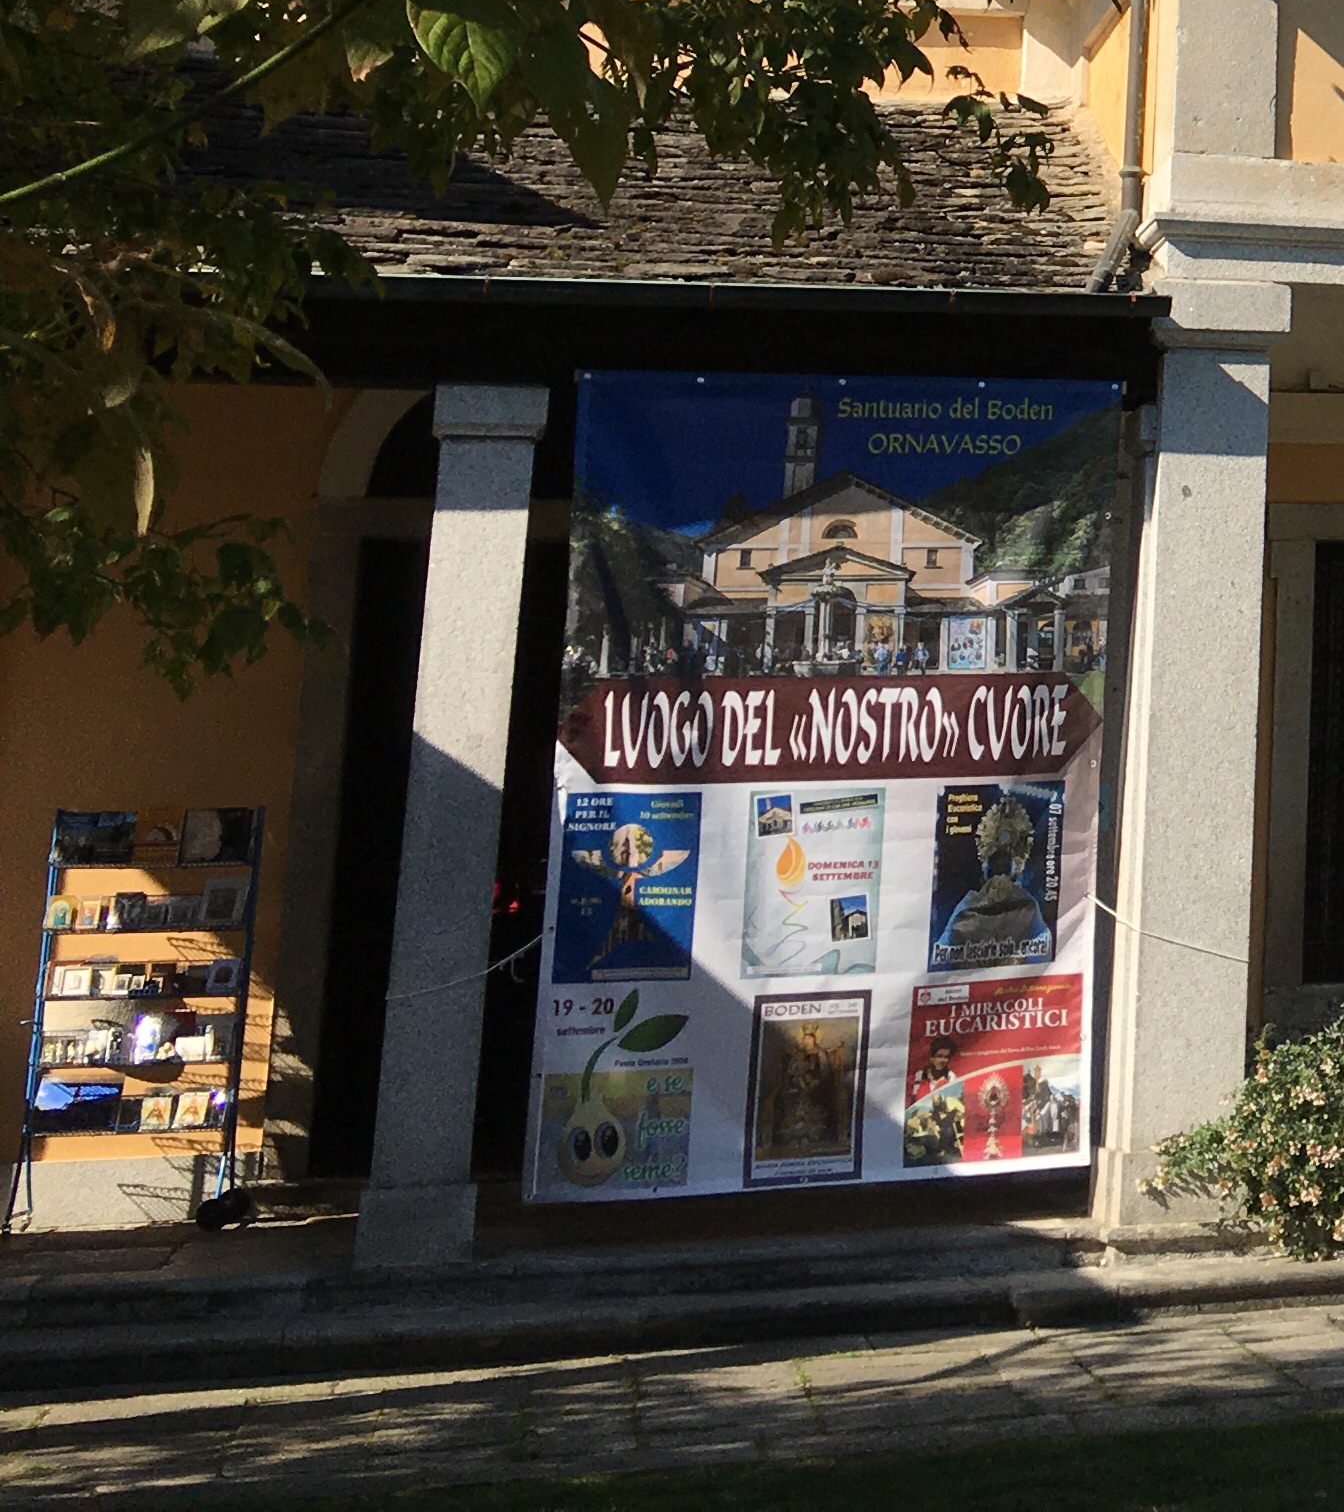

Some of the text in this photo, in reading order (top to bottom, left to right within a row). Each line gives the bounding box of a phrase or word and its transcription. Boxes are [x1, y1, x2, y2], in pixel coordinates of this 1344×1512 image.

[837, 396, 1054, 420] Santuario del Boden
[867, 433, 1022, 455] ORNAVASSO
[603, 690, 713, 768] LUOGO
[721, 690, 781, 766] DEL
[967, 683, 1069, 760] CUORE
[576, 797, 614, 807] 12 ORE
[1049, 803, 1062, 815] 07
[575, 810, 596, 819] PER
[567, 822, 616, 832] SIGNORE
[1046, 817, 1060, 859] settembre
[807, 860, 879, 870] DOMENICA 13
[1046, 860, 1056, 875] ore
[812, 871, 874, 881] SETTEMBRE
[639, 886, 692, 894] CAMMINAR
[638, 897, 692, 906] ADORANDO
[553, 999, 573, 1016] 19
[592, 997, 614, 1015] 20
[764, 1003, 822, 1018] BODEN
[951, 997, 1043, 1018] I MIRACOLI
[924, 1008, 1069, 1038] EUCARISTICI
[637, 1111, 686, 1150] fosse
[623, 1154, 688, 1181] seme?
